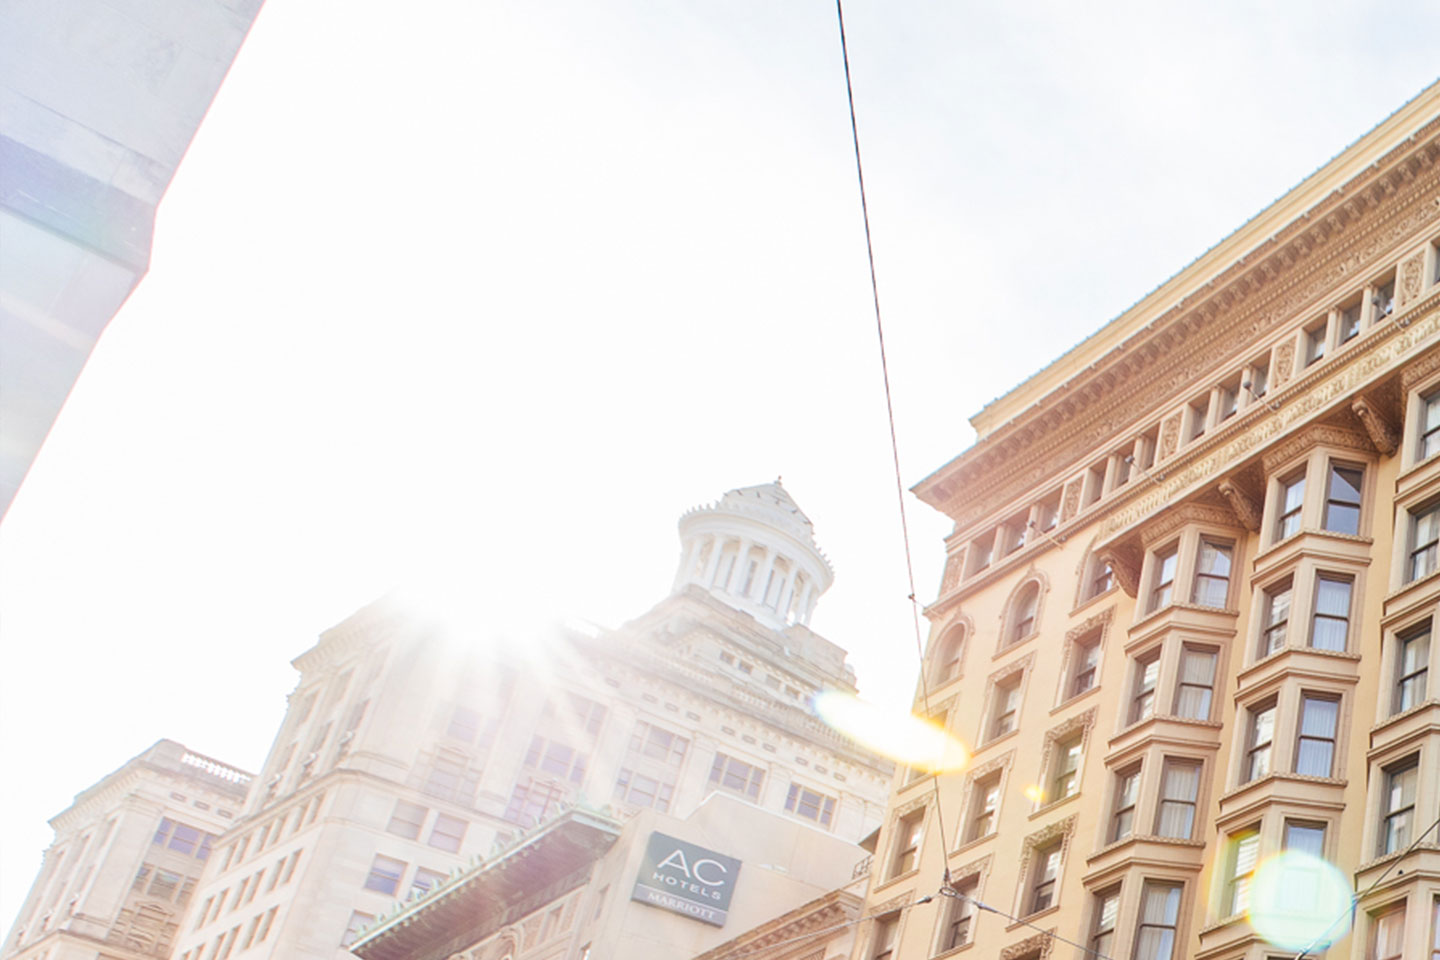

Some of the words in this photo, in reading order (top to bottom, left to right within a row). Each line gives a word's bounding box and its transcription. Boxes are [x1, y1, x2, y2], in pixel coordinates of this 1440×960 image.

[657, 849, 727, 886] AC
[653, 872, 722, 900] HOTELS
[648, 892, 716, 919] MARRIOTT
